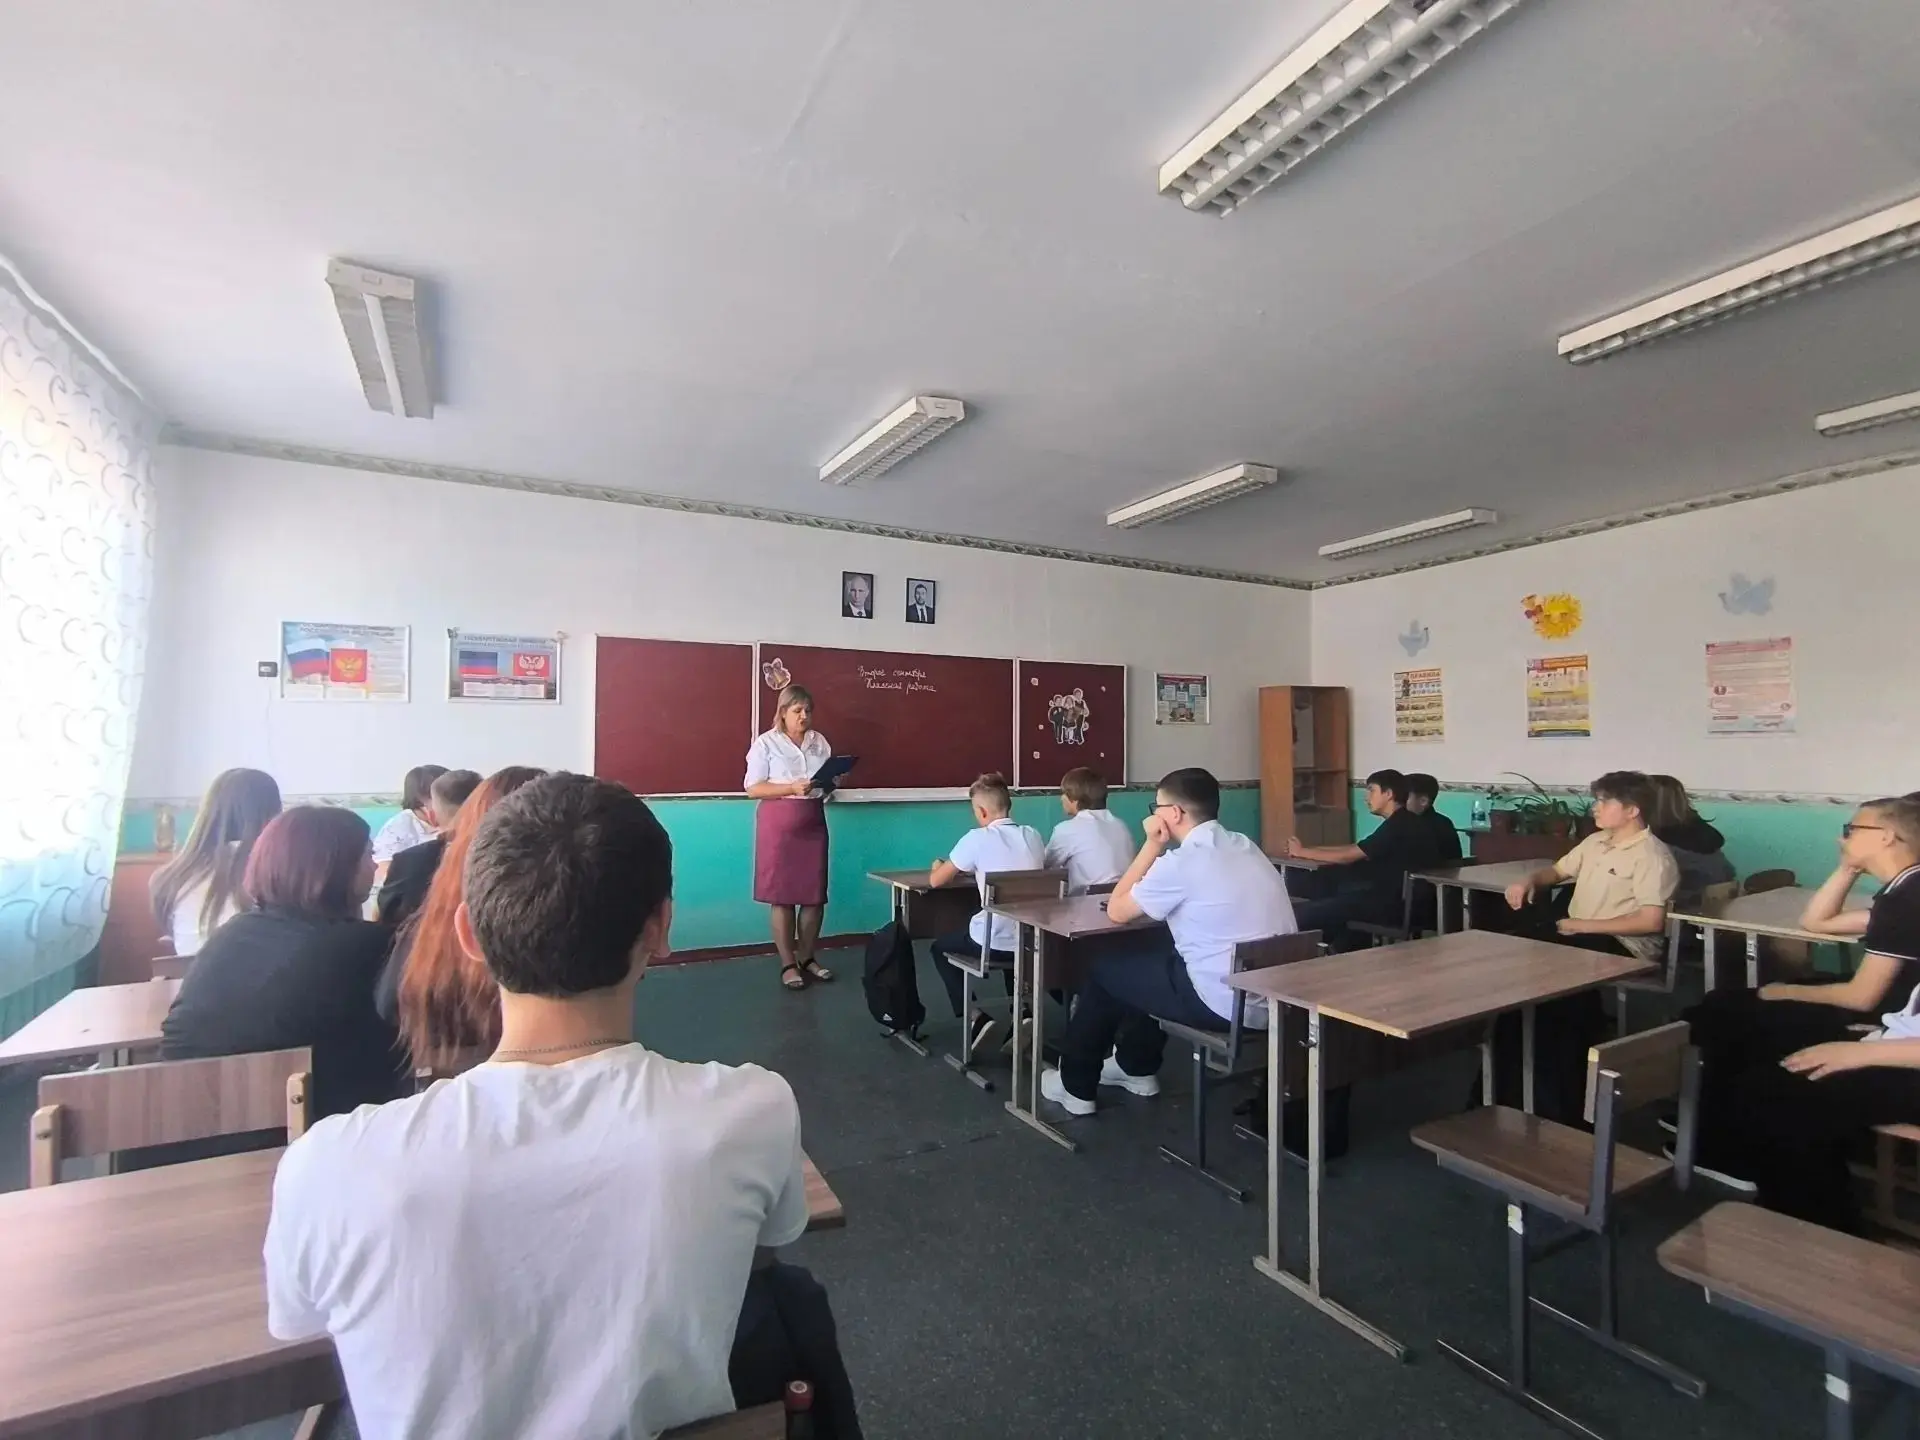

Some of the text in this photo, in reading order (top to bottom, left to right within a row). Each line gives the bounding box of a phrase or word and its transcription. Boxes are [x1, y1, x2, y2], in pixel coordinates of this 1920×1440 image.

[857, 665, 926, 681] Второе сентября
[906, 681, 936, 695] работа
